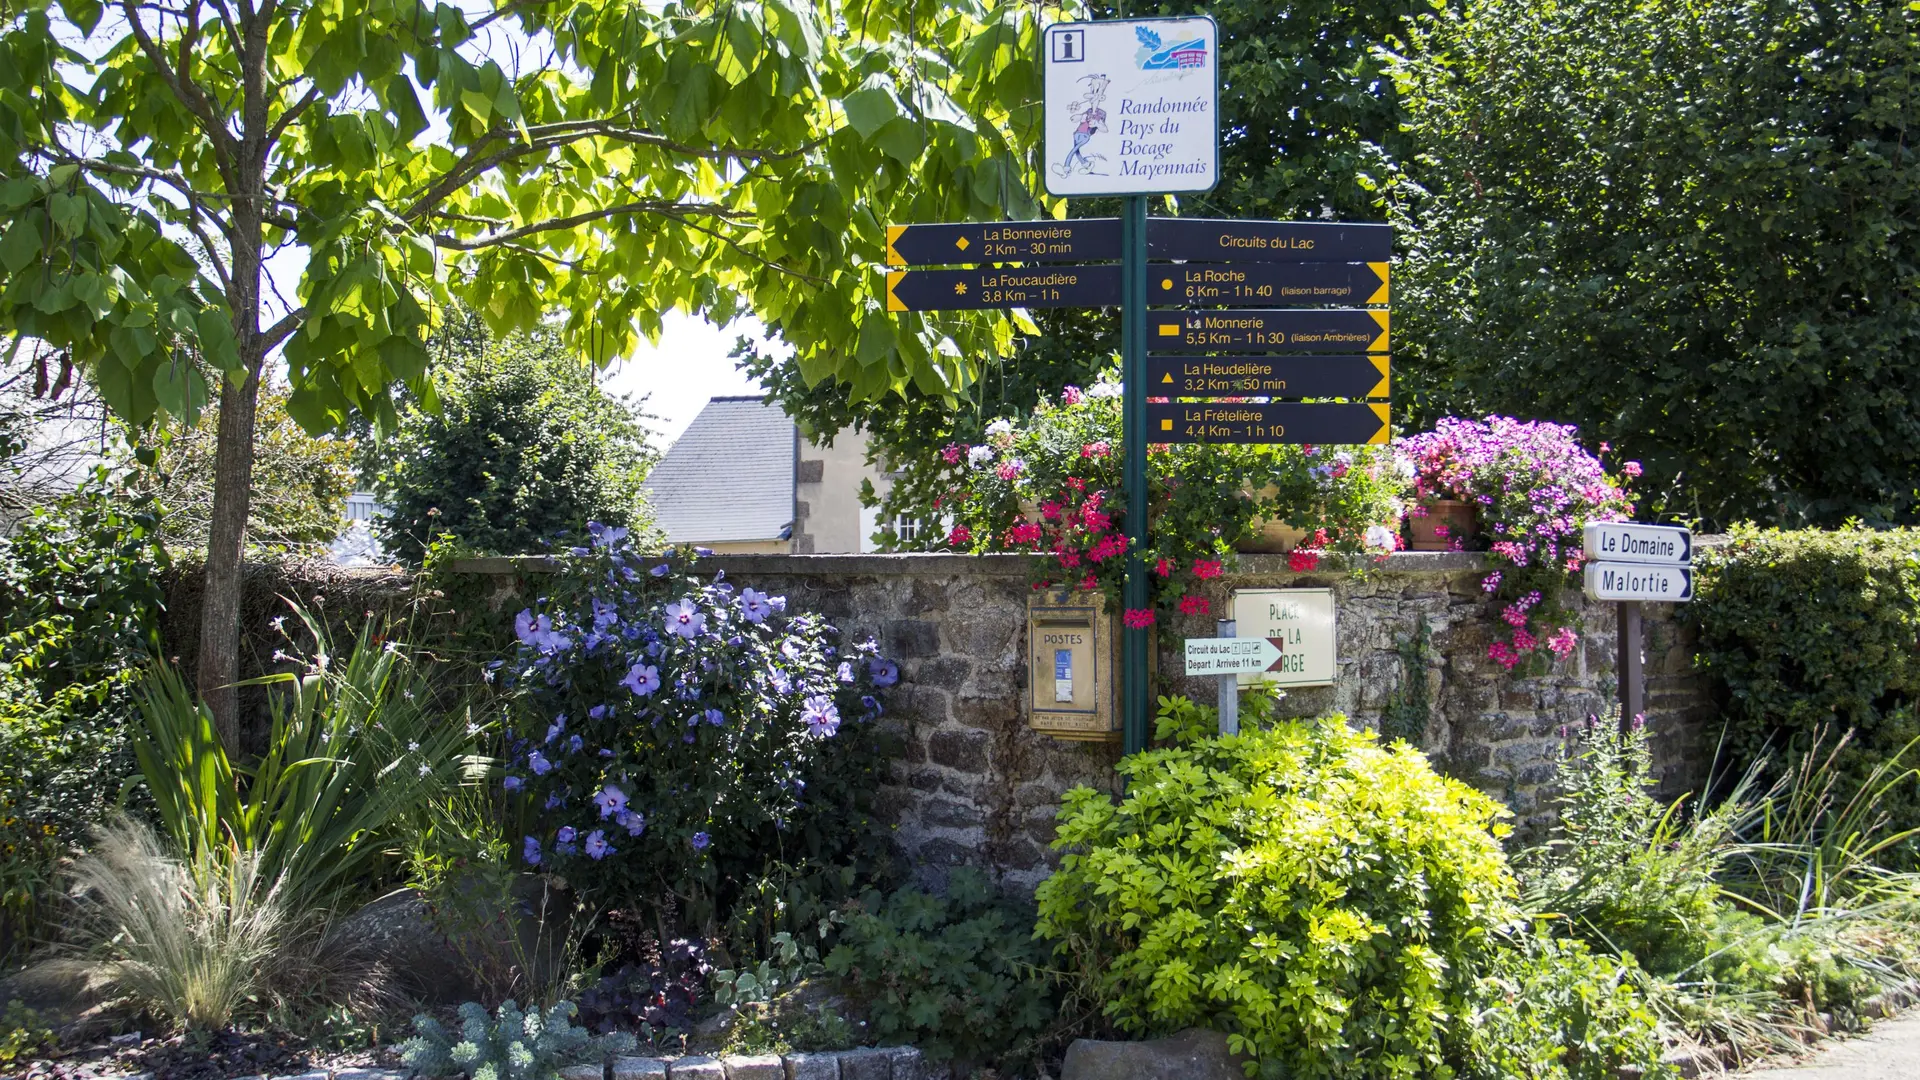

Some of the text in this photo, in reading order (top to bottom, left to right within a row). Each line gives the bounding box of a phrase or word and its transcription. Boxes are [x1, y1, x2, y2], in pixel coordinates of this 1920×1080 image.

[1119, 96, 1208, 114] Randonnée
[1120, 118, 1179, 139] Pays du
[1120, 140, 1173, 160] Bocage
[1119, 158, 1207, 180] Mayennais
[984, 228, 1072, 241] La Bonnevière
[984, 245, 992, 255] 2
[996, 244, 1016, 255] Km
[1030, 243, 1046, 254] 30
[1049, 242, 1071, 253] min
[1220, 235, 1314, 249] Circuits du Lac
[982, 275, 1077, 287] La Foucaudière
[1186, 271, 1245, 282] La Roche
[983, 291, 1002, 303] 3,8
[1005, 290, 1026, 301] Km
[1042, 290, 1047, 300] 1
[1051, 289, 1059, 299] h
[1186, 286, 1194, 297] 6
[1198, 286, 1218, 296] Km
[1235, 286, 1240, 296] 1
[1244, 286, 1253, 296] h
[1256, 285, 1272, 296] 40
[1281, 287, 1312, 296] (liaison
[1314, 287, 1351, 296] barrage)
[1186, 317, 1263, 329] La Monnerie
[1186, 333, 1206, 345] 5,5
[1210, 333, 1230, 344] Km
[1247, 333, 1251, 343] 1
[1257, 333, 1264, 343] h
[1268, 333, 1284, 343] 30
[1291, 333, 1321, 342] (liaison
[1323, 333, 1370, 342] Ambrières)
[1184, 363, 1271, 374] La Heudelière
[1185, 378, 1286, 391] 3,2 Km 50 min
[1185, 410, 1262, 421] La Frételière
[1186, 426, 1205, 437] 4,4
[1209, 425, 1230, 436] Km
[1246, 425, 1252, 436] 1
[1256, 425, 1264, 436] h
[1269, 425, 1284, 436] 10
[1602, 532, 1673, 556] Le Domaine
[1603, 570, 1668, 592] Malortie
[1270, 603, 1300, 620] PLAC
[1044, 635, 1082, 644] POSTES
[1289, 628, 1301, 644] LA
[1188, 644, 1230, 655] Circuit du Lac
[1188, 660, 1211, 671] Départ
[1216, 658, 1240, 668] Arrivée
[1242, 659, 1249, 667] 11
[1251, 658, 1261, 667] km
